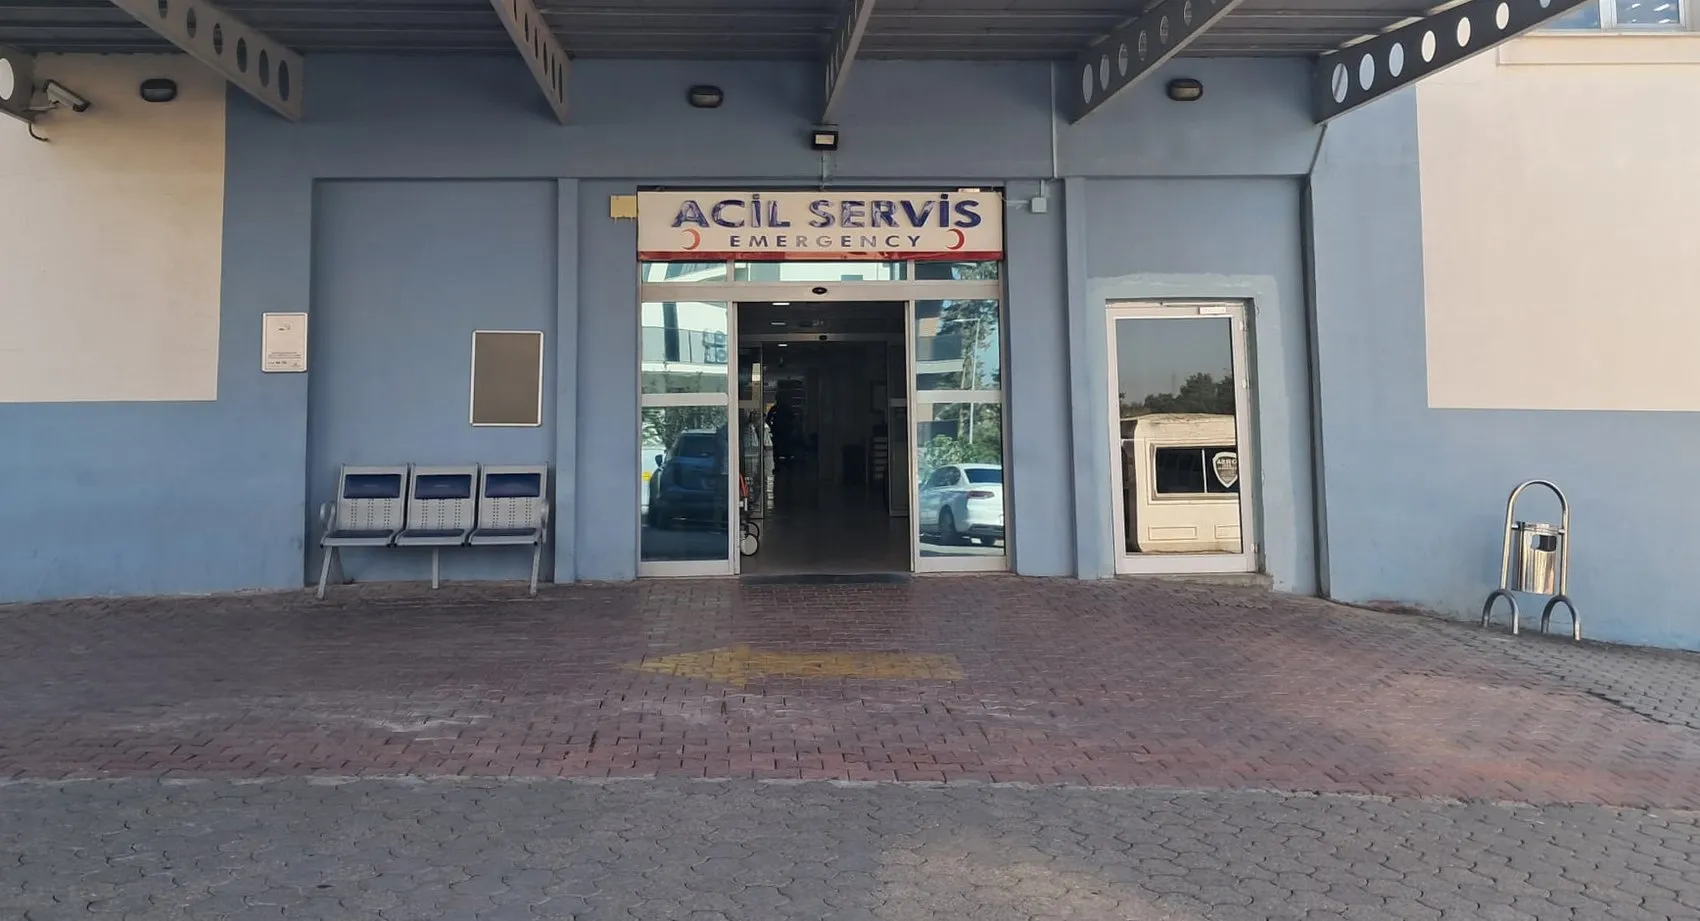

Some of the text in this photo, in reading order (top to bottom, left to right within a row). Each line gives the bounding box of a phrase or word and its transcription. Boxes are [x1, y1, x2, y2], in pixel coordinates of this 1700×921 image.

[671, 193, 982, 228] ACİL SERVİS
[729, 234, 921, 248] EMERGENCY
